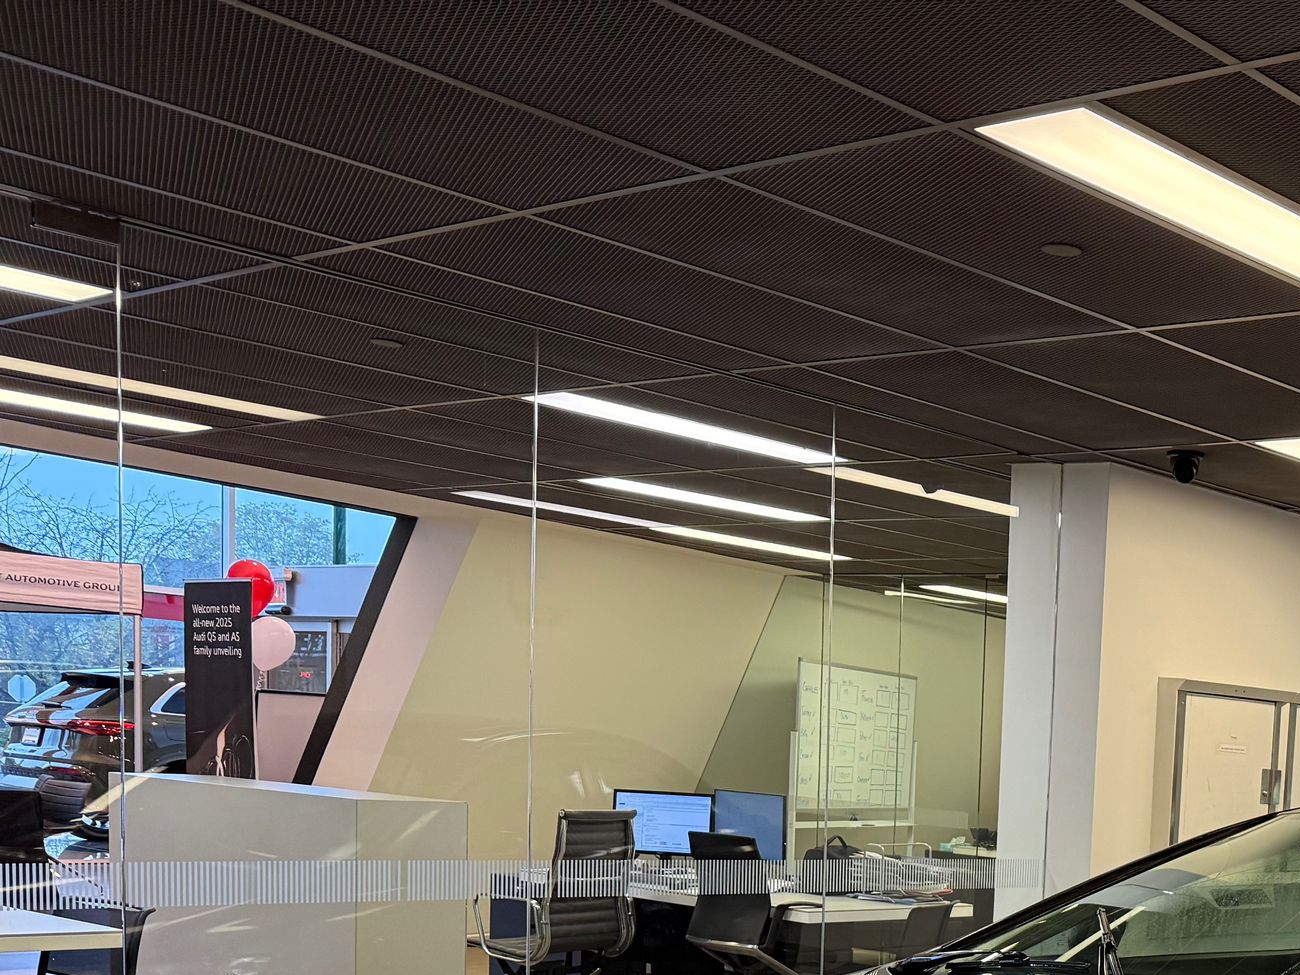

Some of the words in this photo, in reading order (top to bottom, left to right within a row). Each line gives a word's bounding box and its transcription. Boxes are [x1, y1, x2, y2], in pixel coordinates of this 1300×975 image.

[5, 573, 81, 588] AUTOMOTIVE
[191, 603, 220, 613] Welcome
[221, 604, 229, 613] to
[229, 603, 241, 613] the
[192, 618, 215, 628] all-new
[215, 617, 233, 628] 2025
[193, 631, 206, 642] Audi
[206, 631, 217, 642] Q5
[217, 631, 230, 642] and
[230, 631, 240, 642] A5
[193, 645, 212, 658] family
[212, 646, 242, 659] unveiling
